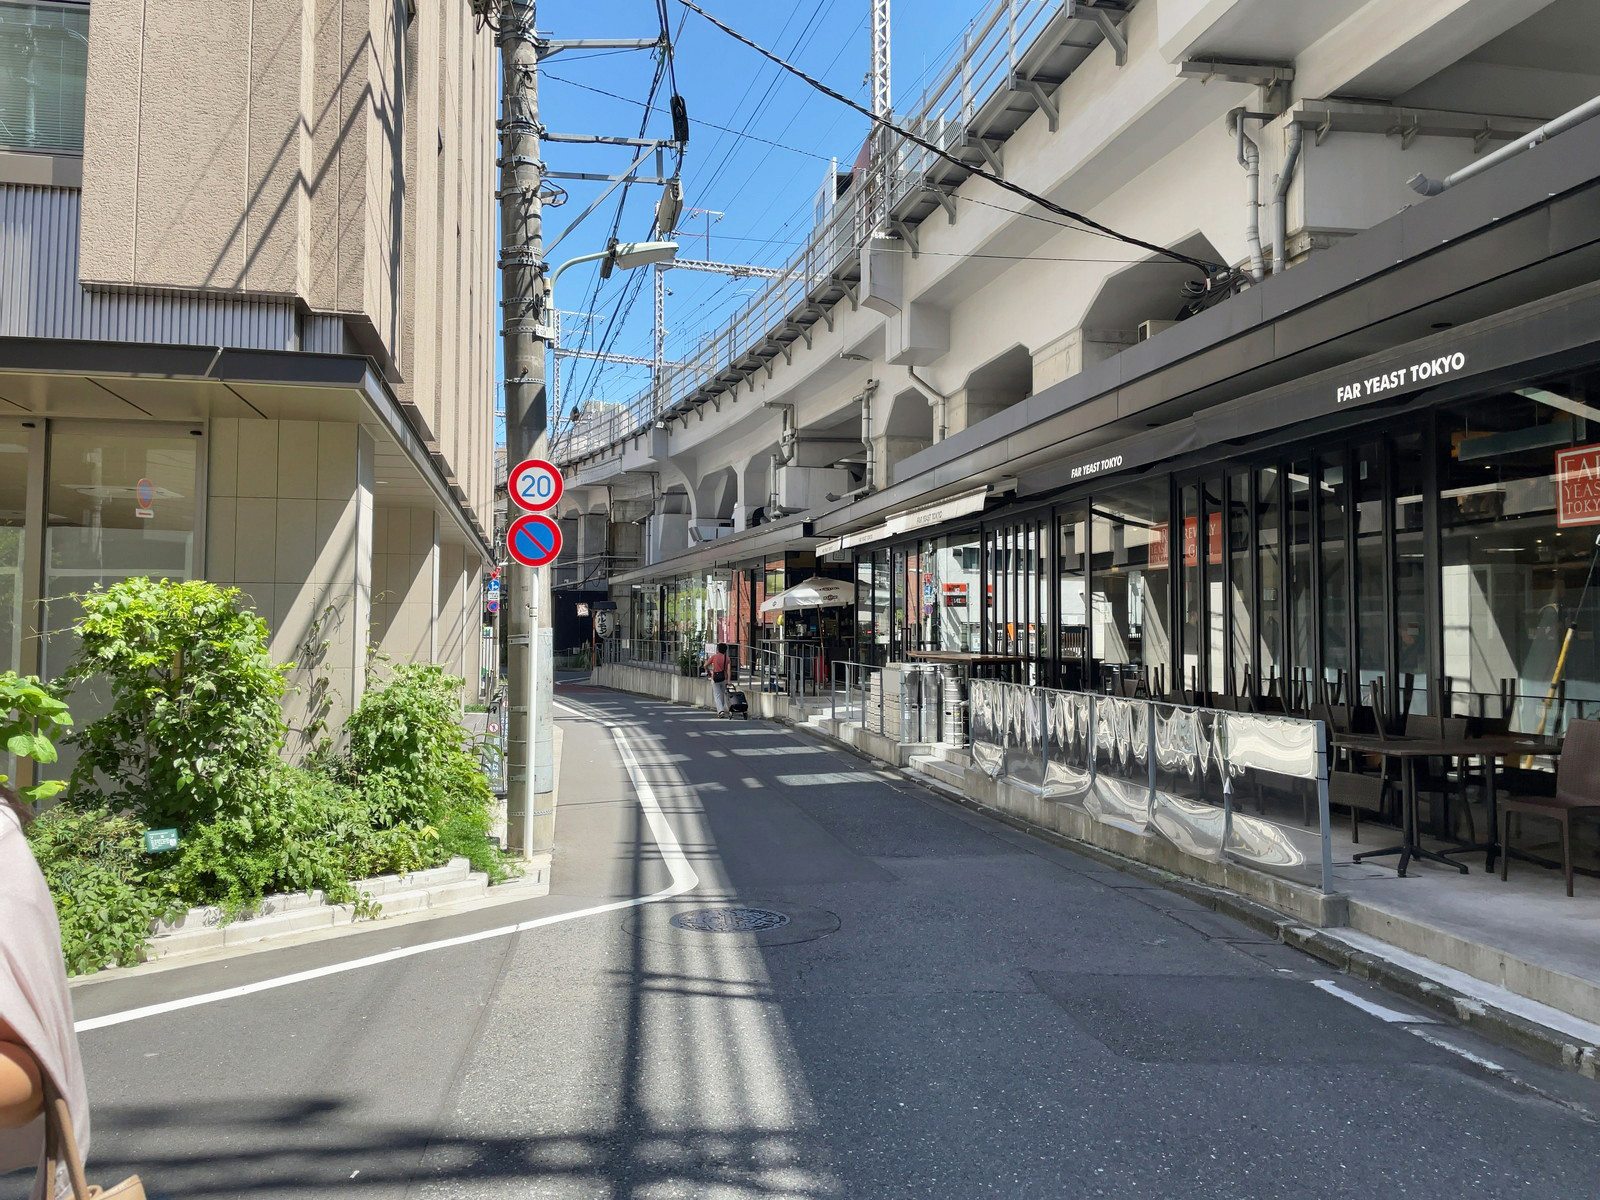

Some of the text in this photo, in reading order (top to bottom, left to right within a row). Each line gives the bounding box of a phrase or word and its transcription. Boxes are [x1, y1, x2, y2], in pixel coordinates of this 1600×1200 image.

[1337, 352, 1465, 402] FAR YEAST TOKYO
[1071, 455, 1123, 478] FAR YEAST TOKYO
[521, 474, 551, 497] 20
